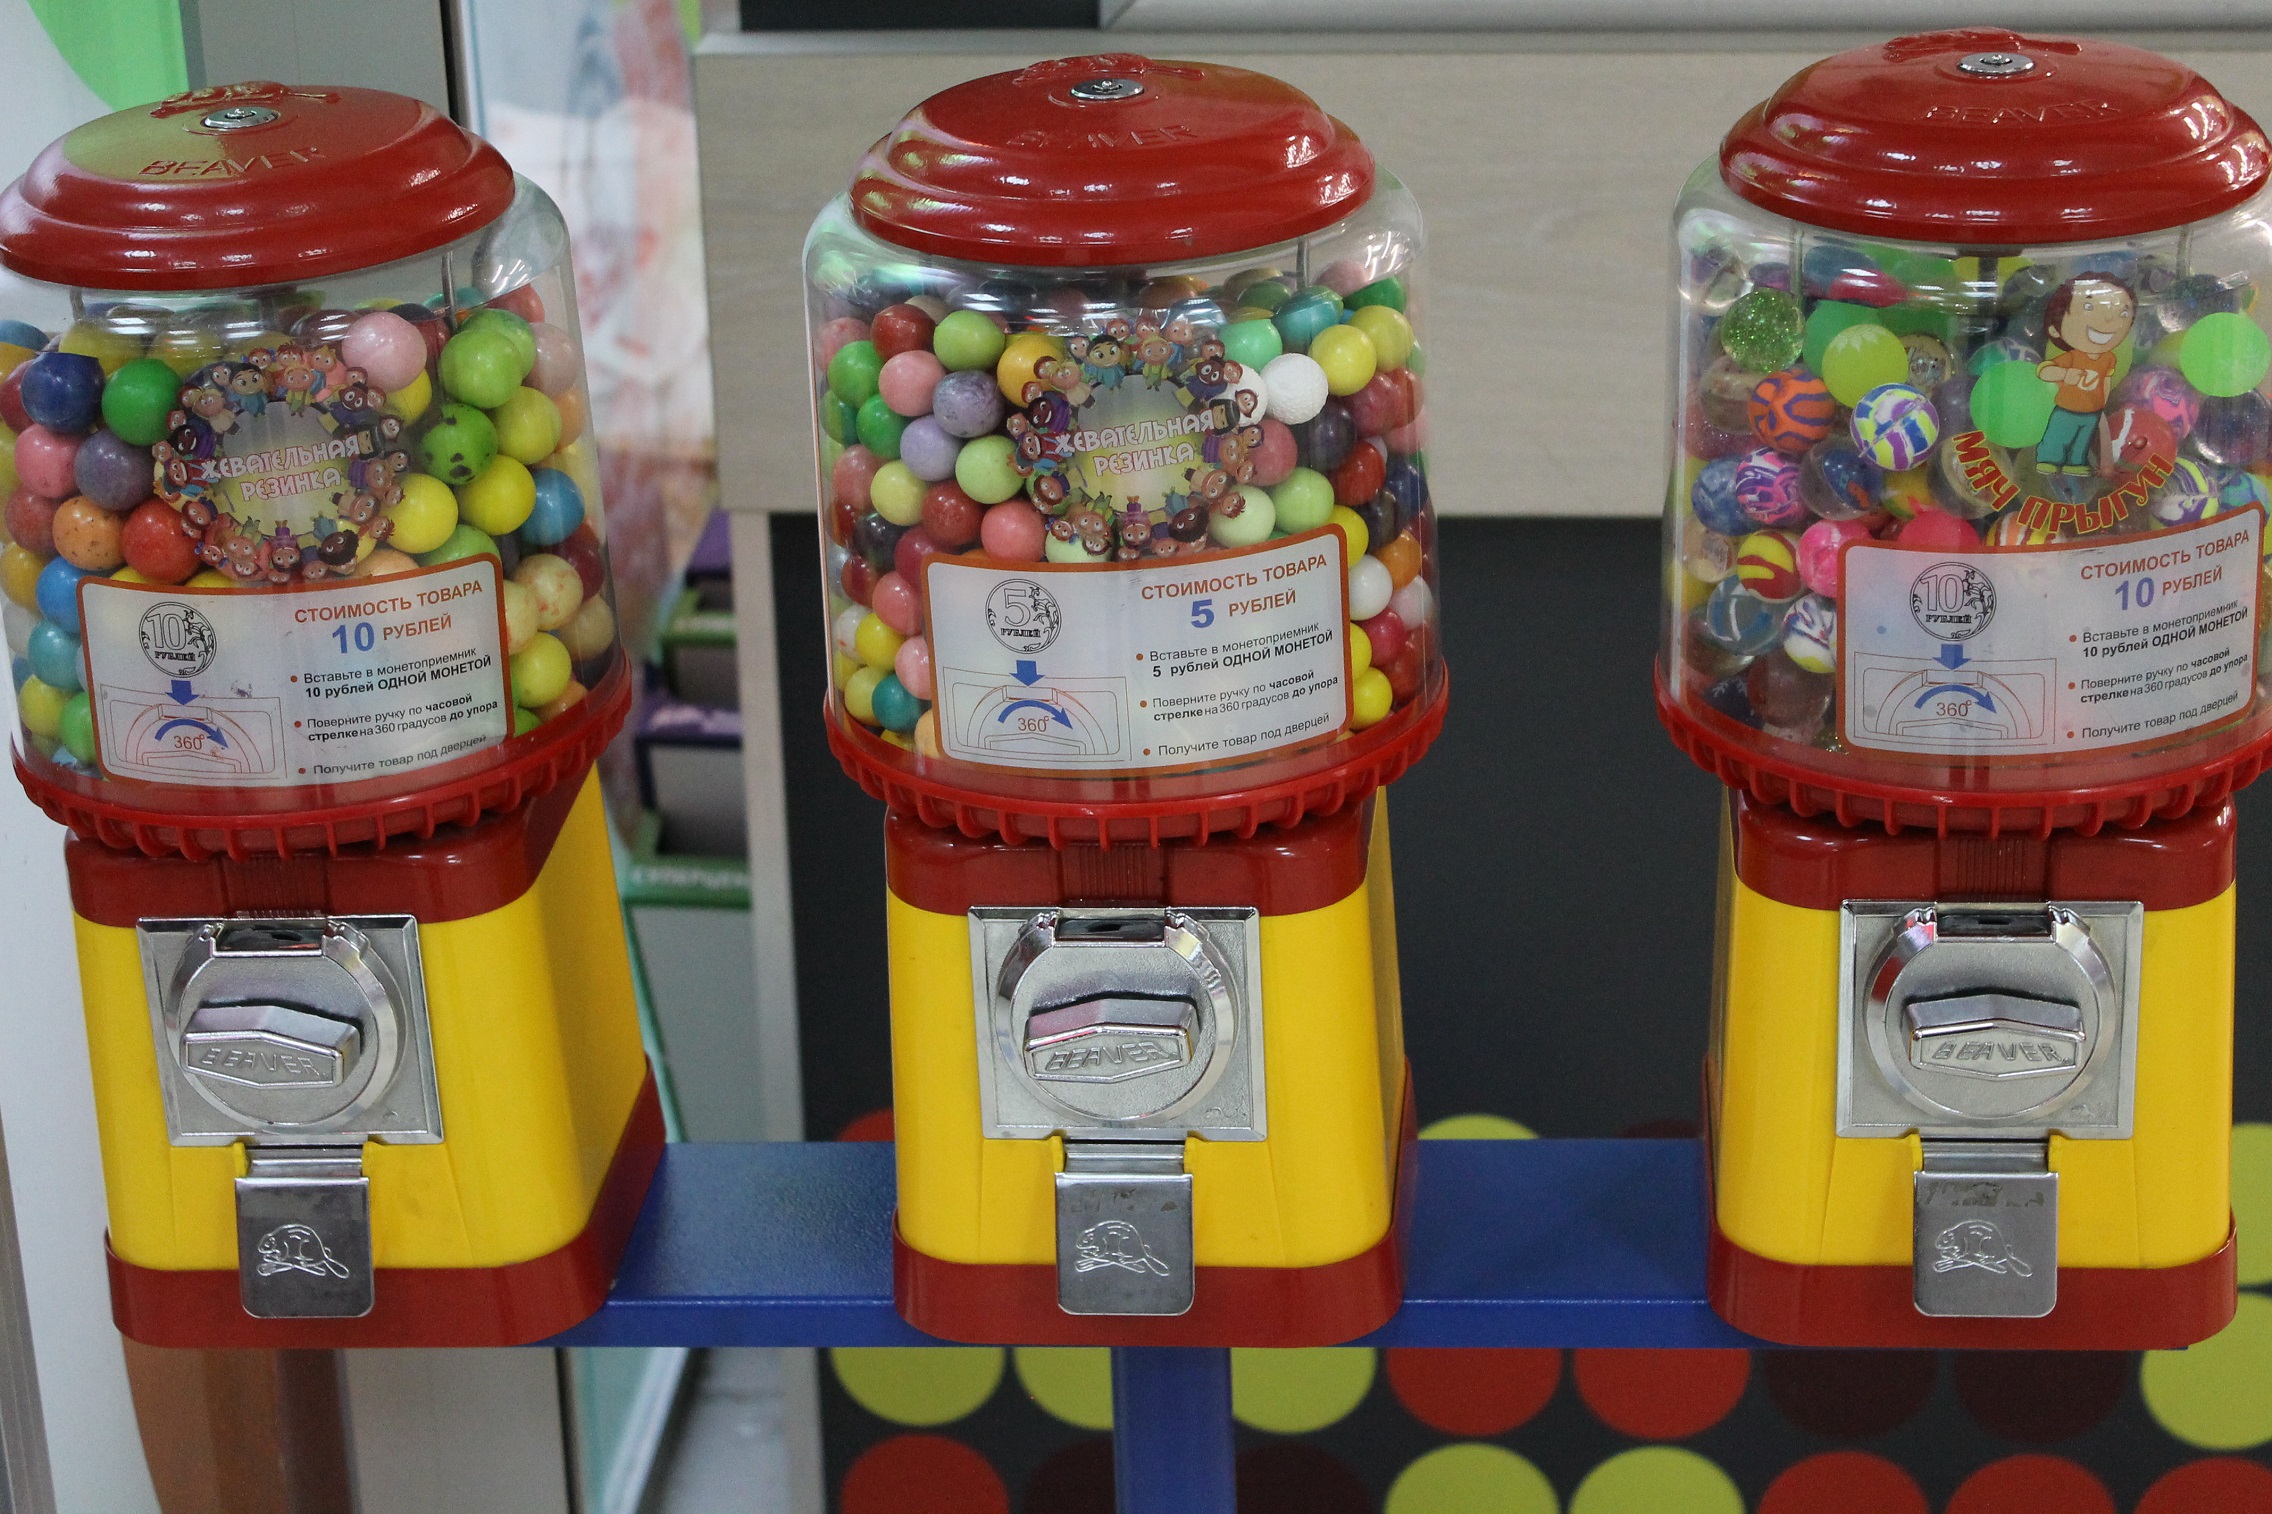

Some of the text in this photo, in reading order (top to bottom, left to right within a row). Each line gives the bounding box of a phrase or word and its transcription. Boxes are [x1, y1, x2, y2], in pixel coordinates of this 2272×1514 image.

[139, 147, 324, 175] BEAVER
[1055, 410, 1214, 453] ЖЕВАТЕЛЬНАЯ
[201, 435, 360, 479] ЖЕВАТЕЛЬНАЯ
[1093, 443, 1194, 476] РЕЗИНКА
[240, 468, 341, 501] РЕЗИНКА
[1953, 431, 2175, 534] МЯЧ ПРЫГУН
[2080, 529, 2249, 581] СТОИМОСТЬ ТОВАРА
[1141, 554, 1327, 601] СТОИМОСТЬ ТОВАРА
[1920, 573, 1965, 612] 10
[2114, 566, 2223, 611] 10 РУБЛЕЙ
[294, 580, 483, 624] СТОИМОСТЬ ТОВАРА
[1002, 588, 1031, 626] 5
[1190, 590, 1296, 628] 5 РУБЛЕЙ
[1925, 613, 1972, 624] РУБЛЕЙ
[2083, 599, 2238, 643] Вставьте в монетоприемник
[146, 611, 188, 651] 10
[332, 615, 452, 654] 10 РУБЛЕЙ
[1000, 627, 1041, 639] РУБЛЕЙ
[1149, 622, 1319, 662] Вставьте в монетоприемник
[2083, 607, 2248, 659] 10 рублей ОДНОЙ МОНЕТОЙ
[154, 651, 196, 662] РУБЛЕЙ
[304, 646, 476, 684] Вставьте в монетоприемник
[1153, 630, 1333, 677] 5 рублей ОДНОЙ МОНЕТОЙ
[2081, 648, 2230, 690] Поверните ручку по часовой
[305, 655, 491, 698] 10 рублей ОДНОЙ МОНЕТОЙ
[1153, 669, 1314, 709] Поверните ручку по часовой
[2080, 652, 2248, 703] стрелке на 360 градусов до упора
[307, 694, 473, 730] Поверните ручку по часовой
[1153, 675, 1338, 723] стрелке на 360 градусов до упора
[2082, 691, 2238, 740] Получите товар под дверцей
[308, 701, 498, 743] стрелке на 360 градусов до упора
[1158, 713, 1330, 757] Получите товар под дверцей
[313, 734, 486, 776] Получите товар под дверцей
[203, 1046, 320, 1076] BEAVER
[1046, 1042, 1169, 1072] BEAVER
[1933, 1040, 2063, 1063] BEAVER
